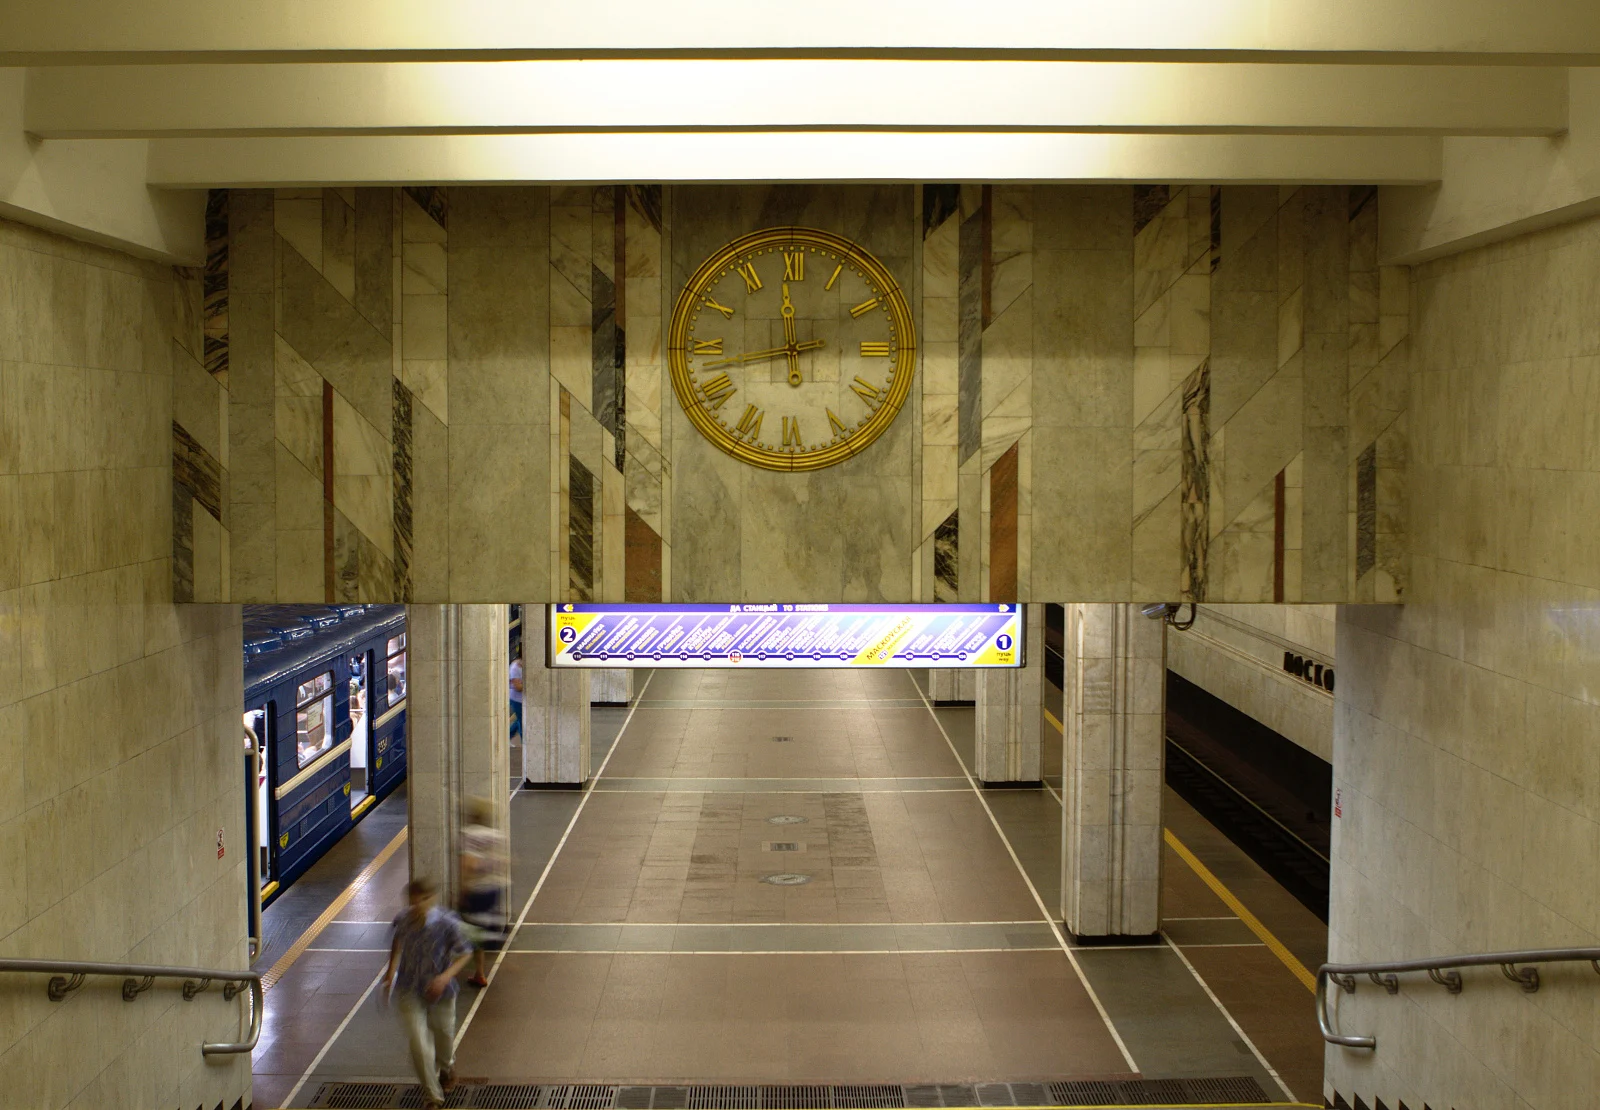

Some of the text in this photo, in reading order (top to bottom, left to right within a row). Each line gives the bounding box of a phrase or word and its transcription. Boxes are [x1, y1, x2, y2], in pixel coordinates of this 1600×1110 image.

[736, 262, 764, 294] XI
[783, 252, 804, 281] XII
[825, 264, 842, 291] I
[705, 296, 735, 319] X
[849, 298, 878, 319] II
[694, 338, 724, 355] IX
[860, 341, 890, 357] III
[701, 372, 738, 410] VIII
[850, 376, 880, 407] IV
[736, 403, 765, 440] VII
[782, 416, 802, 446] VI
[825, 407, 846, 436] V
[563, 629, 573, 641] 2
[999, 636, 1007, 648] 1
